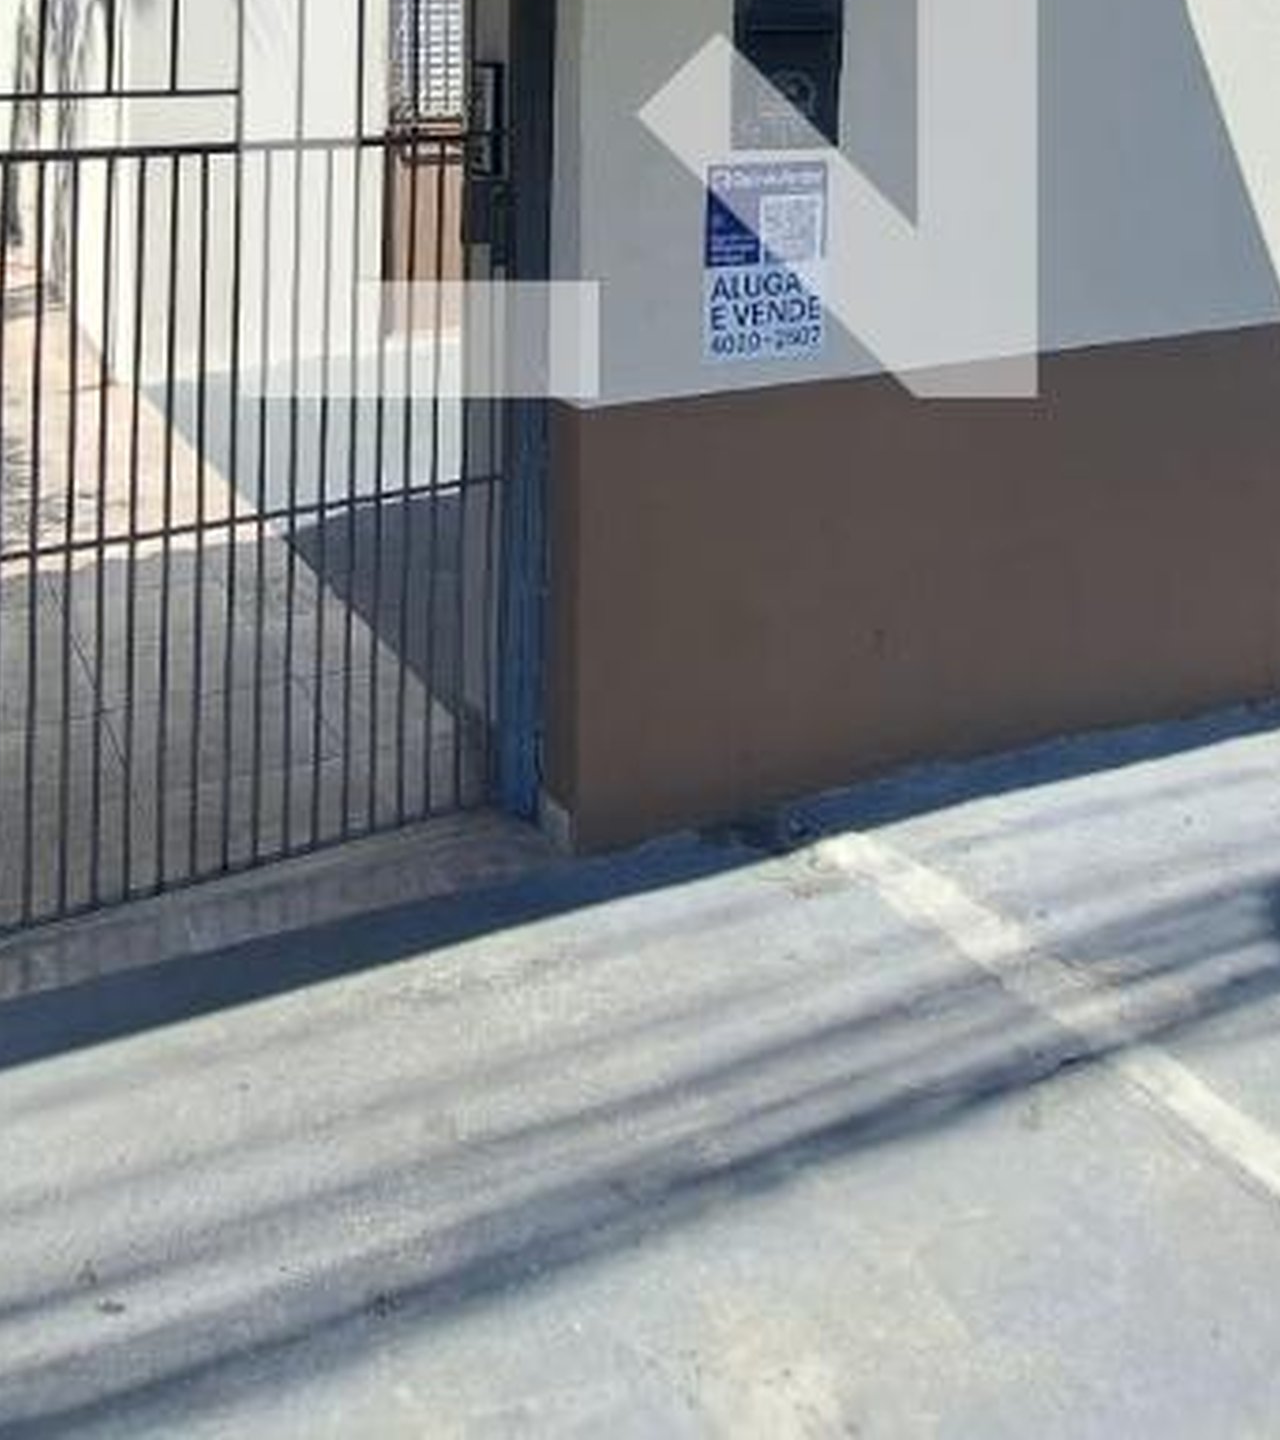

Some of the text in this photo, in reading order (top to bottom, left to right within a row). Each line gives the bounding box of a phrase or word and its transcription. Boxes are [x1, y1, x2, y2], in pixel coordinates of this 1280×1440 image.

[710, 271, 802, 303] ALUGA
[710, 296, 821, 331] E VENDE
